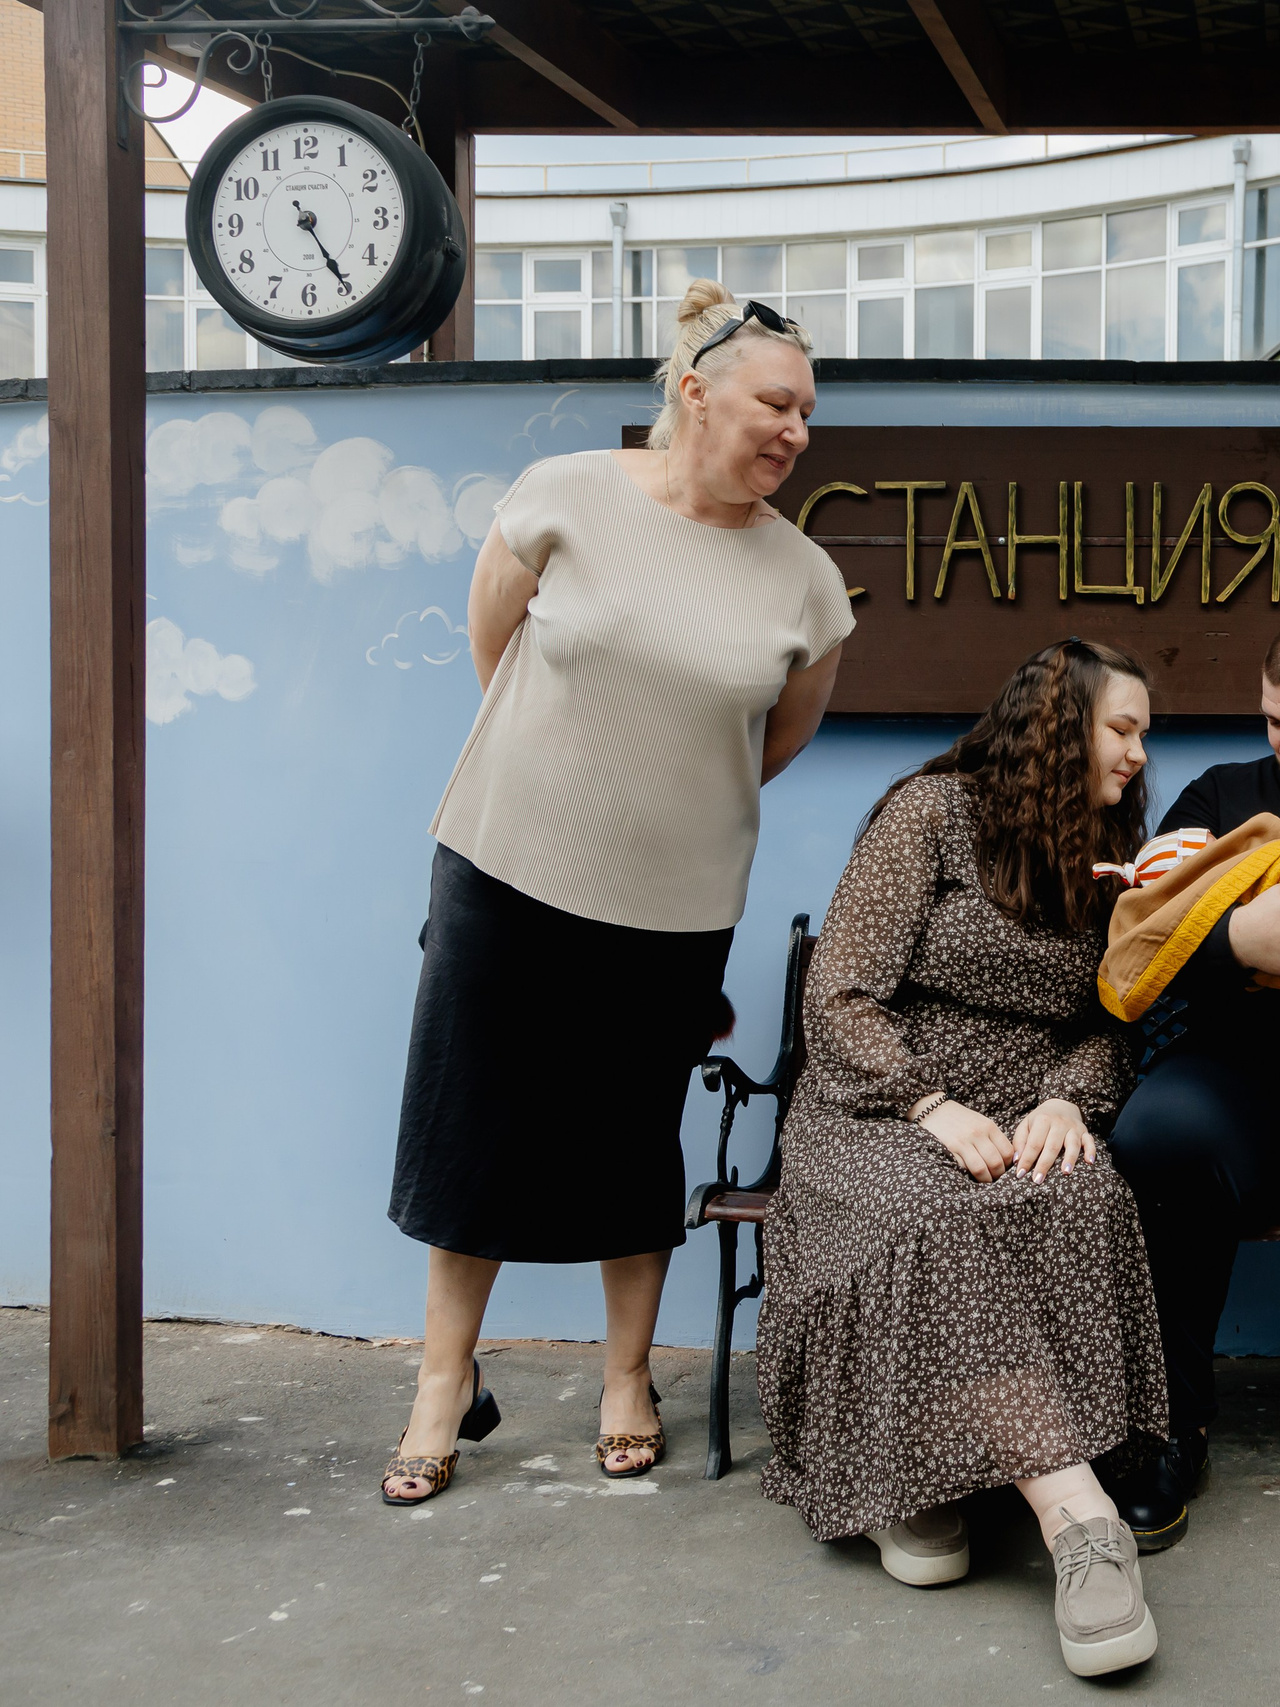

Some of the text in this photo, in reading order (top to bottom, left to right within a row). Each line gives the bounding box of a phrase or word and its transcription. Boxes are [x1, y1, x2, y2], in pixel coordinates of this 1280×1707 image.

[293, 135, 319, 160] 12
[337, 144, 348, 167] 1
[261, 148, 281, 172] 11
[234, 176, 260, 201] 10
[285, 183, 329, 192] СТАНЦИЯ СЧАСТЬЯ
[362, 169, 379, 193] 2
[227, 213, 244, 238] 9
[372, 206, 390, 231] 3
[238, 249, 255, 274] 8
[361, 243, 378, 266] 4
[267, 275, 284, 299] 7
[301, 283, 317, 307] 6
[336, 272, 353, 297] 5
